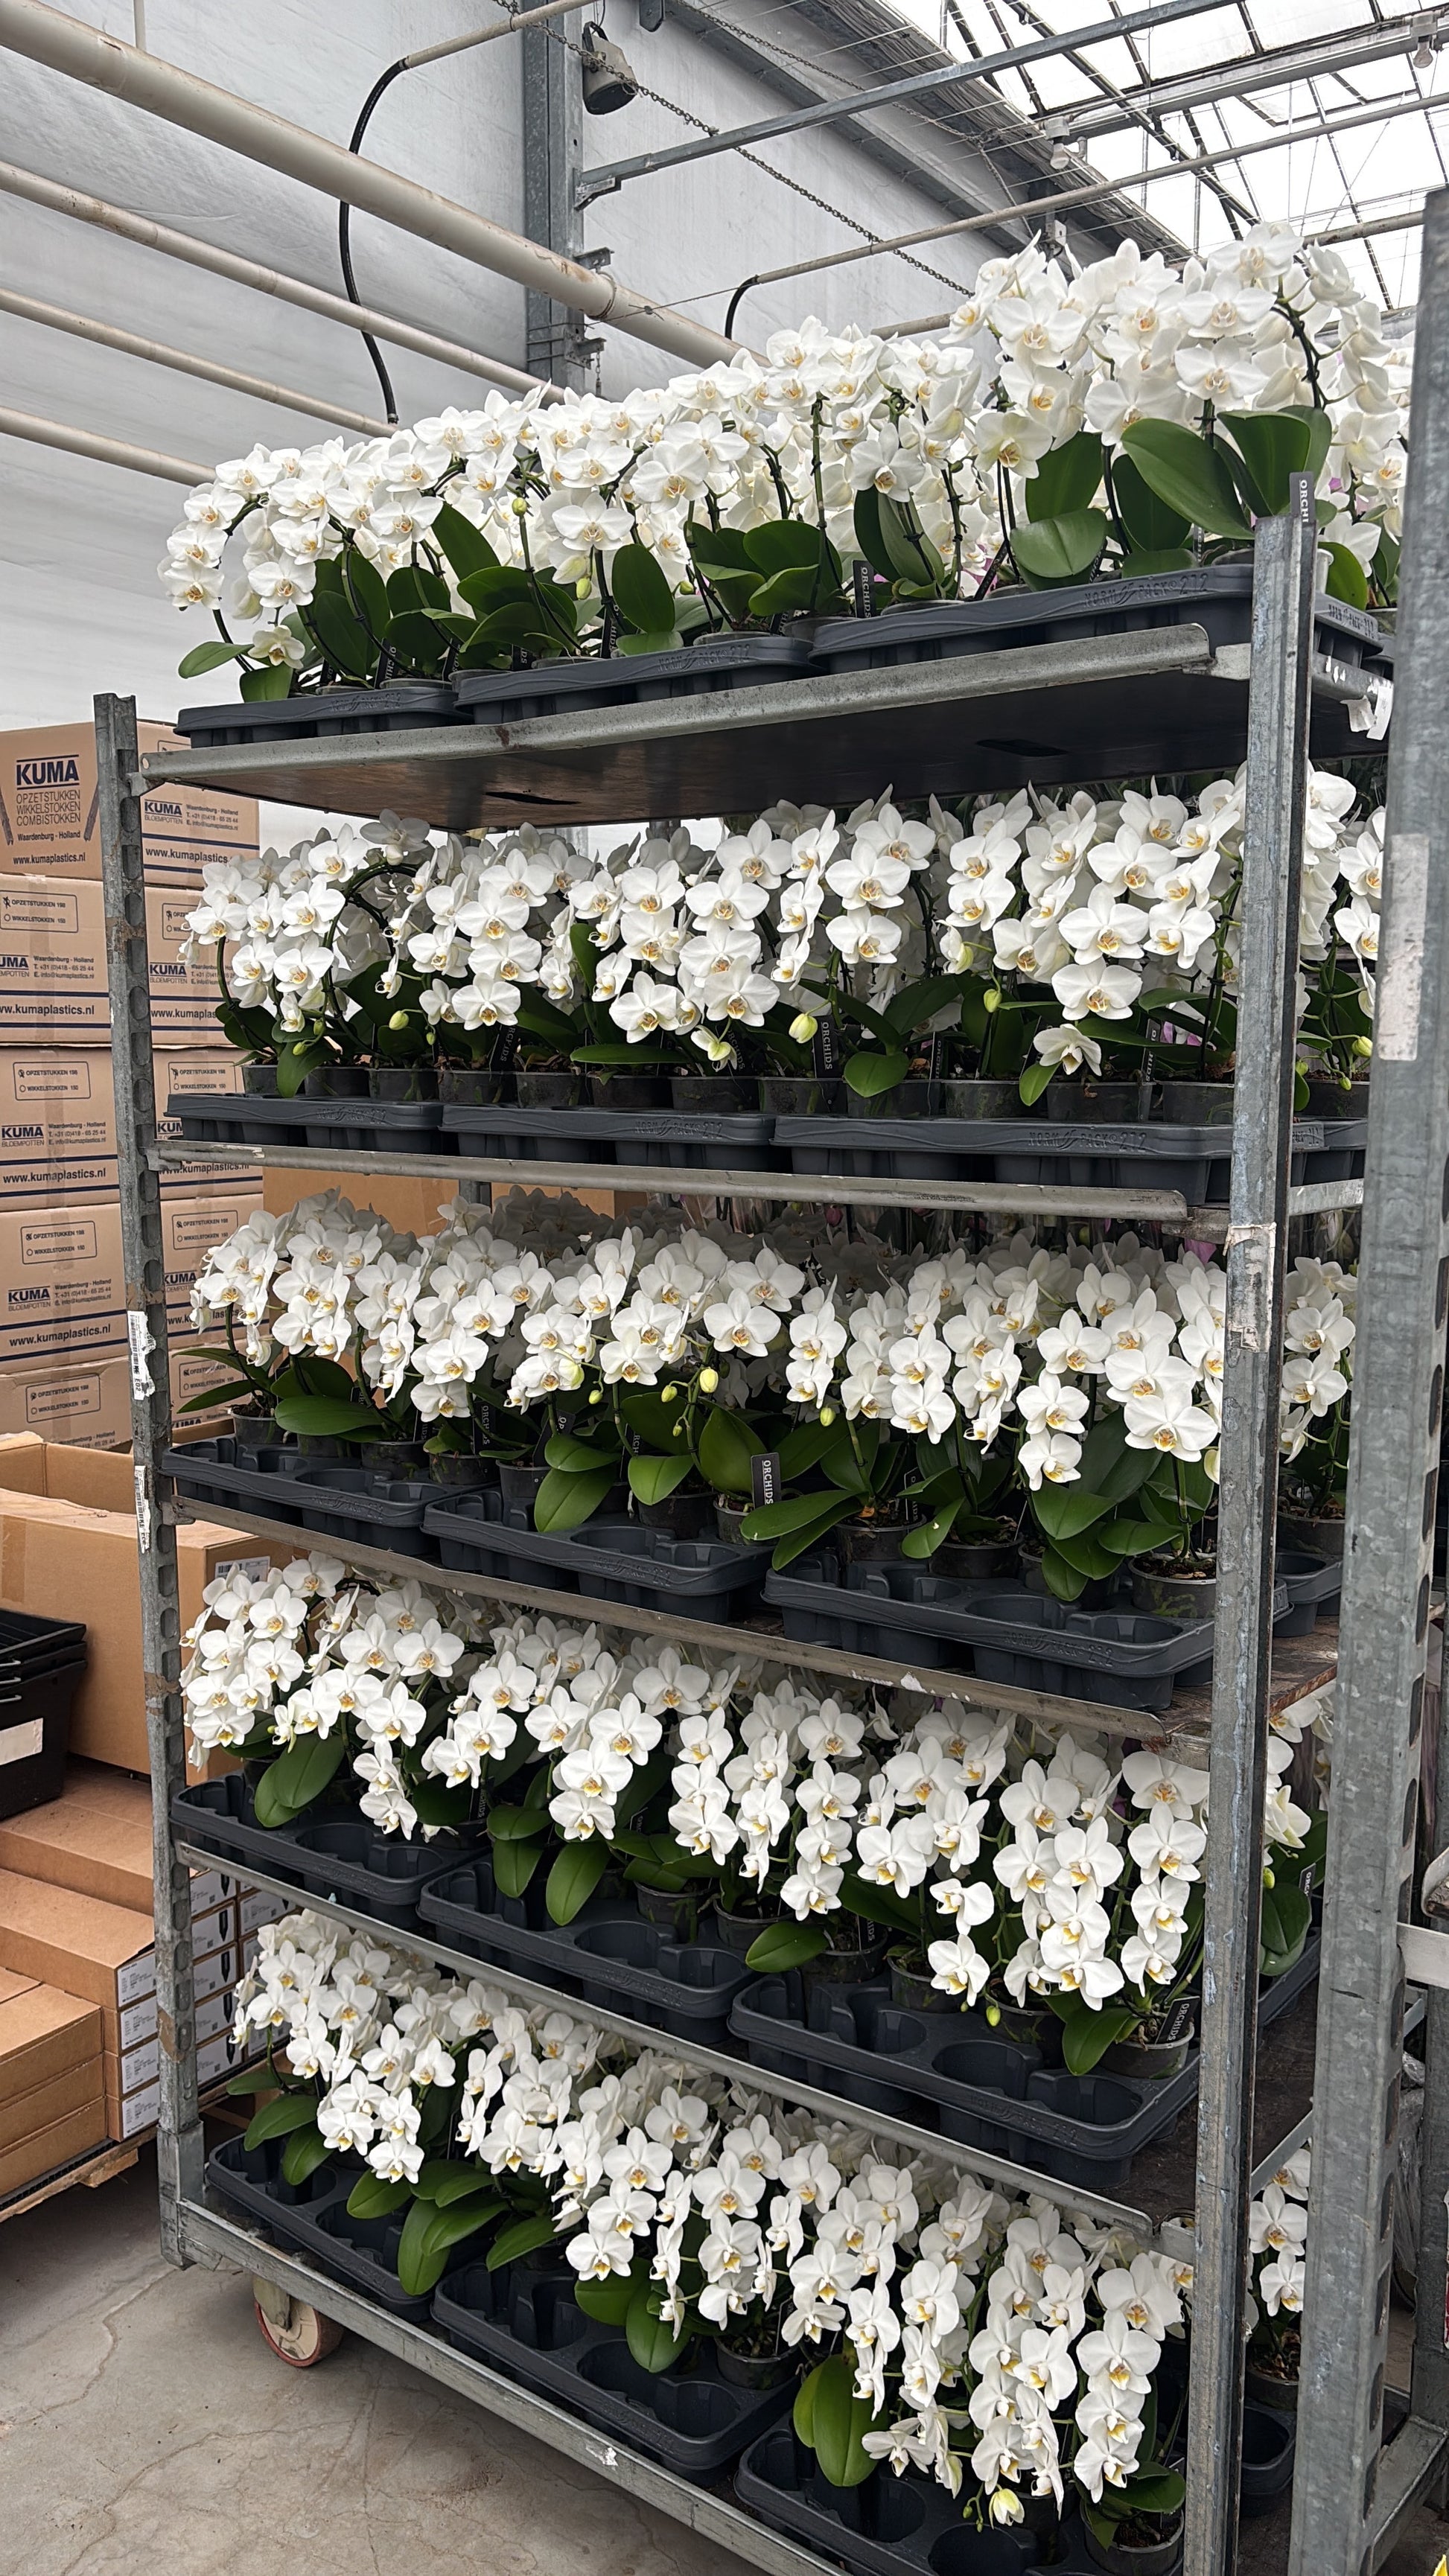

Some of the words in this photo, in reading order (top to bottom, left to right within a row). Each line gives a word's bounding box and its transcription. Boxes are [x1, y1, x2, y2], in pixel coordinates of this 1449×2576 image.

[1299, 479, 1309, 523] ORCHI
[861, 567, 872, 618] ORCHIDS
[16, 760, 79, 785] KUMA
[16, 790, 80, 804] OPZETSTUKKEN
[16, 801, 80, 815] WIKKELSTOKKEN
[144, 802, 182, 816] KUMA
[220, 808, 238, 816] Holland
[16, 813, 80, 826] COMBISTOKKEN
[144, 814, 183, 825] BLOEMPOTTEN
[17, 833, 54, 841] Waardenburg
[59, 831, 80, 839] Holland
[13, 853, 86, 865] www.kumaplastics.nl
[145, 847, 230, 864] www.kumaplastics.
[12, 899, 56, 908] OPZETSTUKKEN
[12, 915, 55, 924] WIKKELSTOKKEN
[0, 957, 29, 969] UMA
[34, 955, 69, 964] Waardenburg
[150, 964, 186, 975] KUMA
[0, 1004, 95, 1016] ww.kumaplastics.nl
[151, 1008, 217, 1021] www.kumaplas
[500, 1027, 516, 1062] RCHIDS
[822, 1021, 833, 1071] ORCHIDS
[1, 1126, 43, 1138] KUMA
[157, 1122, 182, 1133] KUM
[1, 1139, 45, 1148] BLOEMPOTTEN
[3, 1167, 106, 1184] www.kumaplastics.nl
[34, 1231, 74, 1240] OPZETSTUKKEN
[34, 1246, 74, 1254] WIKKELSTOKKEN
[54, 1281, 89, 1290] Waardenburg
[8, 1288, 50, 1302] KUMA
[8, 1301, 51, 1312] BLOEMPOTTEN
[10, 1324, 111, 1347] www.kumaplastics.nl
[38, 1387, 79, 1398] OPZETSTUKKEN
[763, 1460, 774, 1505] ORCHIDS
[1168, 2003, 1190, 2041] ORCHIDS
